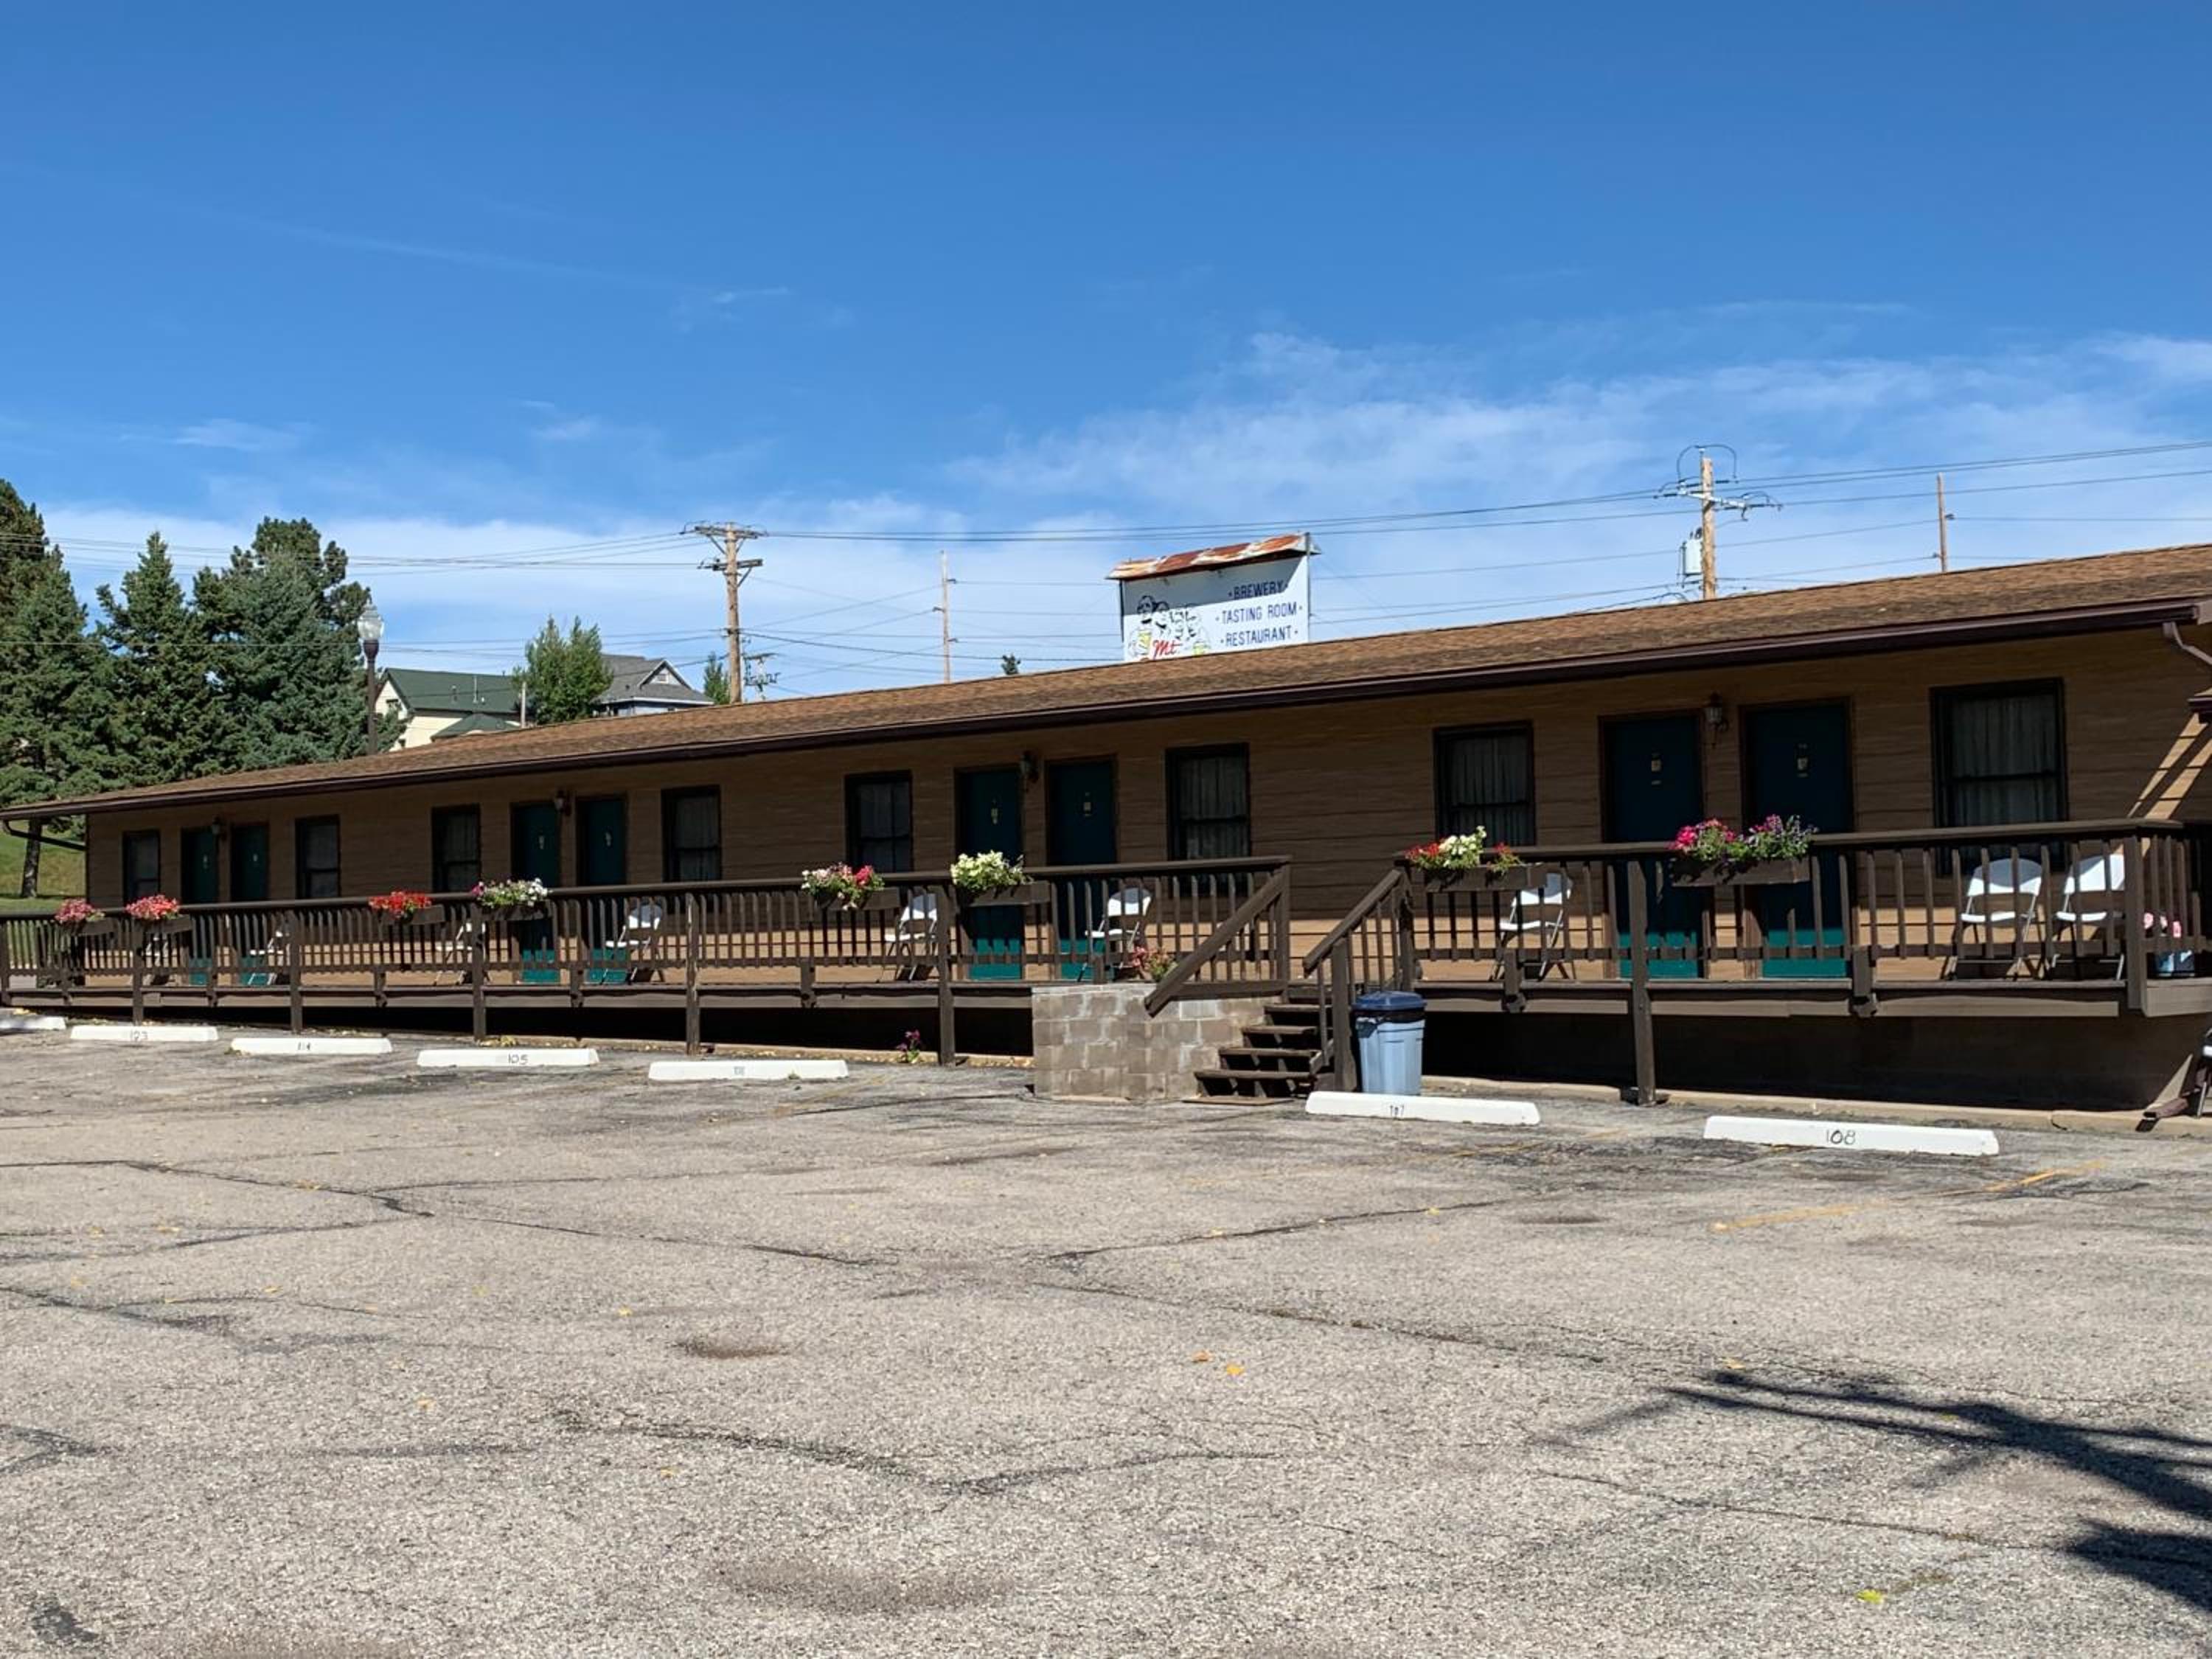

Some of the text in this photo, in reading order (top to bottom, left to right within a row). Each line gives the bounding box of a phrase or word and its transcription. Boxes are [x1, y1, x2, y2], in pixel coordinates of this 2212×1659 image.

[1234, 580, 1283, 599] BREWERY
[1222, 602, 1298, 624] TASTING ROOM
[1225, 626, 1292, 647] RESTAURANT
[507, 1053, 529, 1065] 105
[1826, 1130, 1856, 1145] 108
